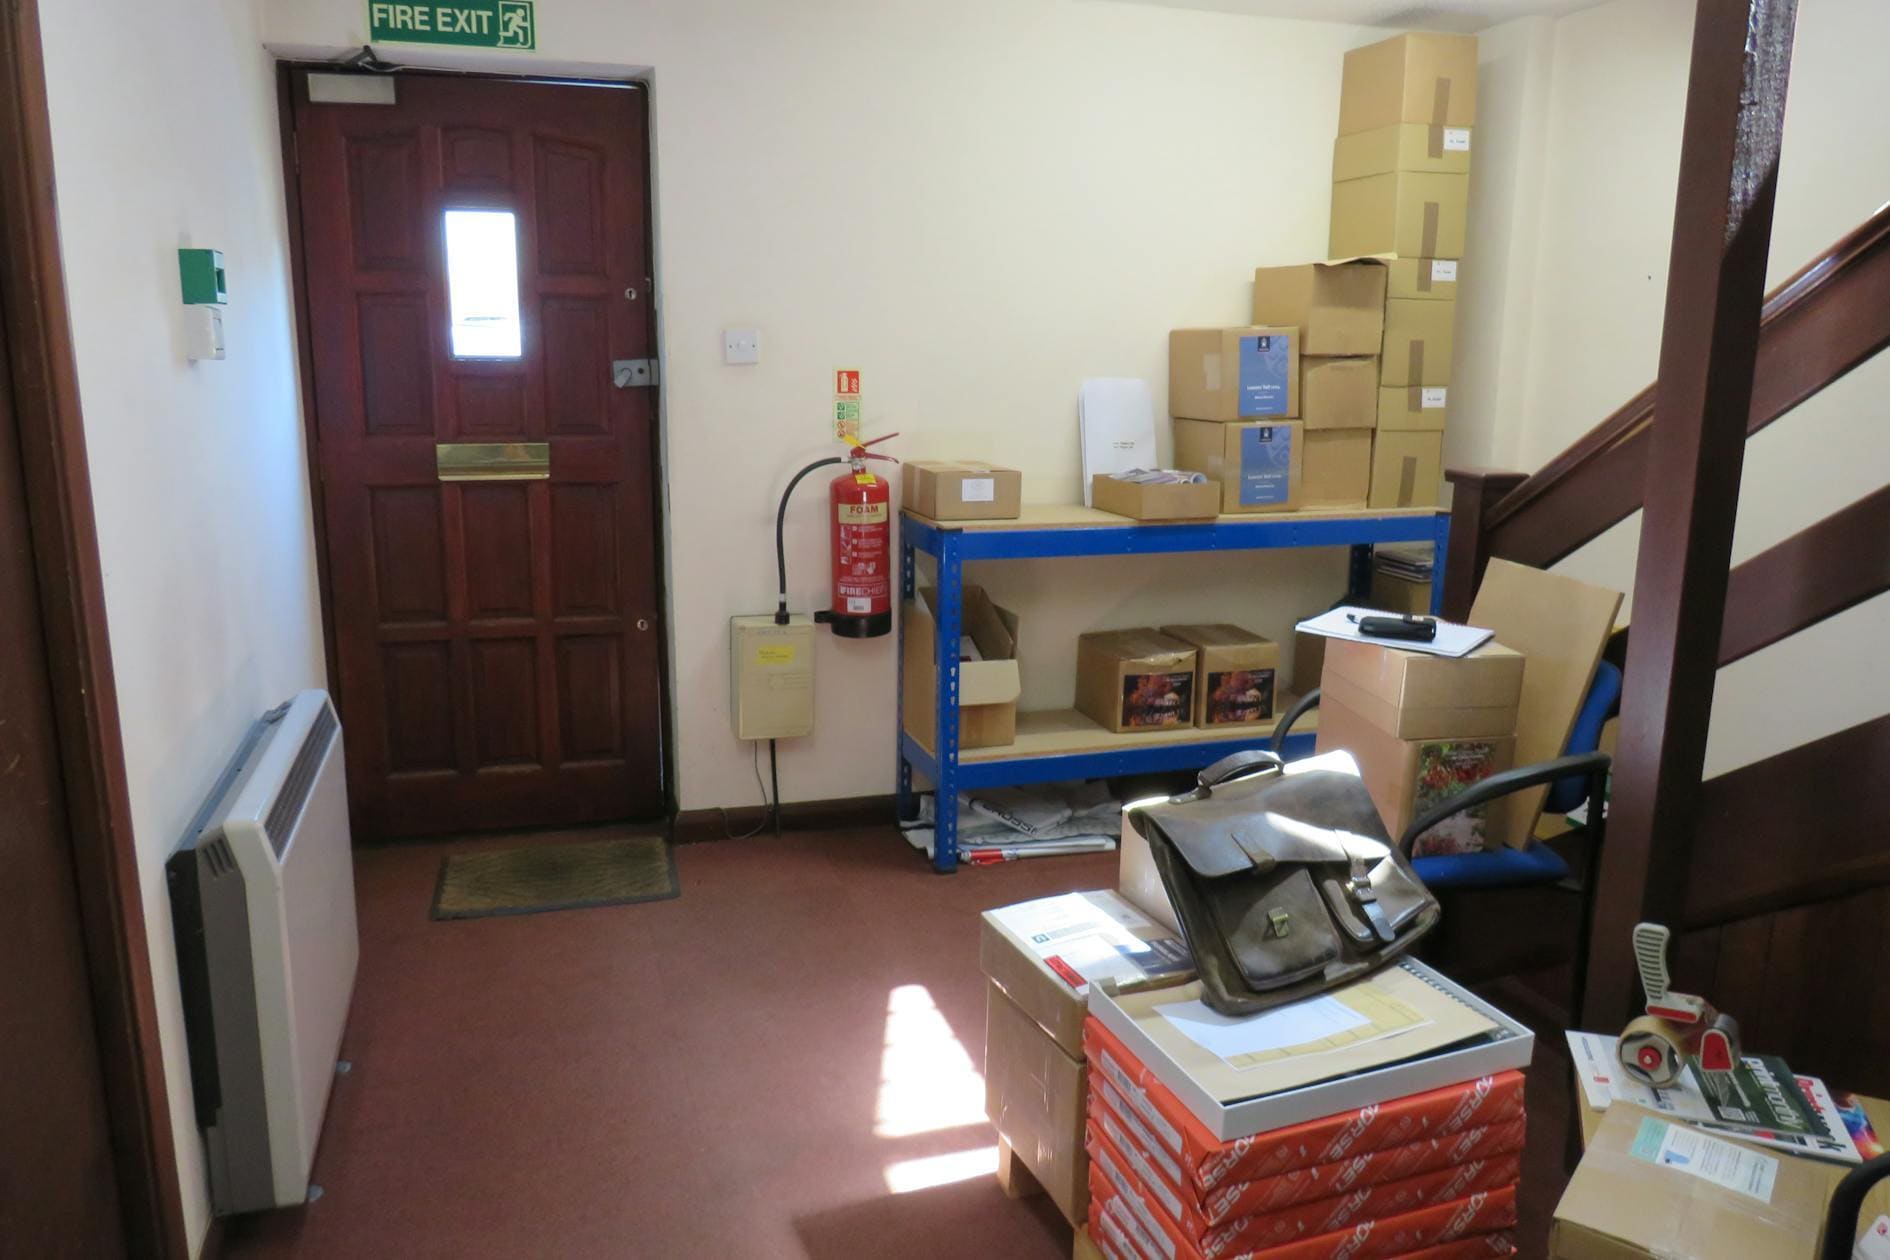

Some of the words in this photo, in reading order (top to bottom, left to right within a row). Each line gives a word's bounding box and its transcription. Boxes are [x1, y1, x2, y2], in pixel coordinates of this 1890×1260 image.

[372, 3, 431, 31] FIRE
[437, 8, 493, 35] EXIT
[849, 505, 879, 513] FOAM
